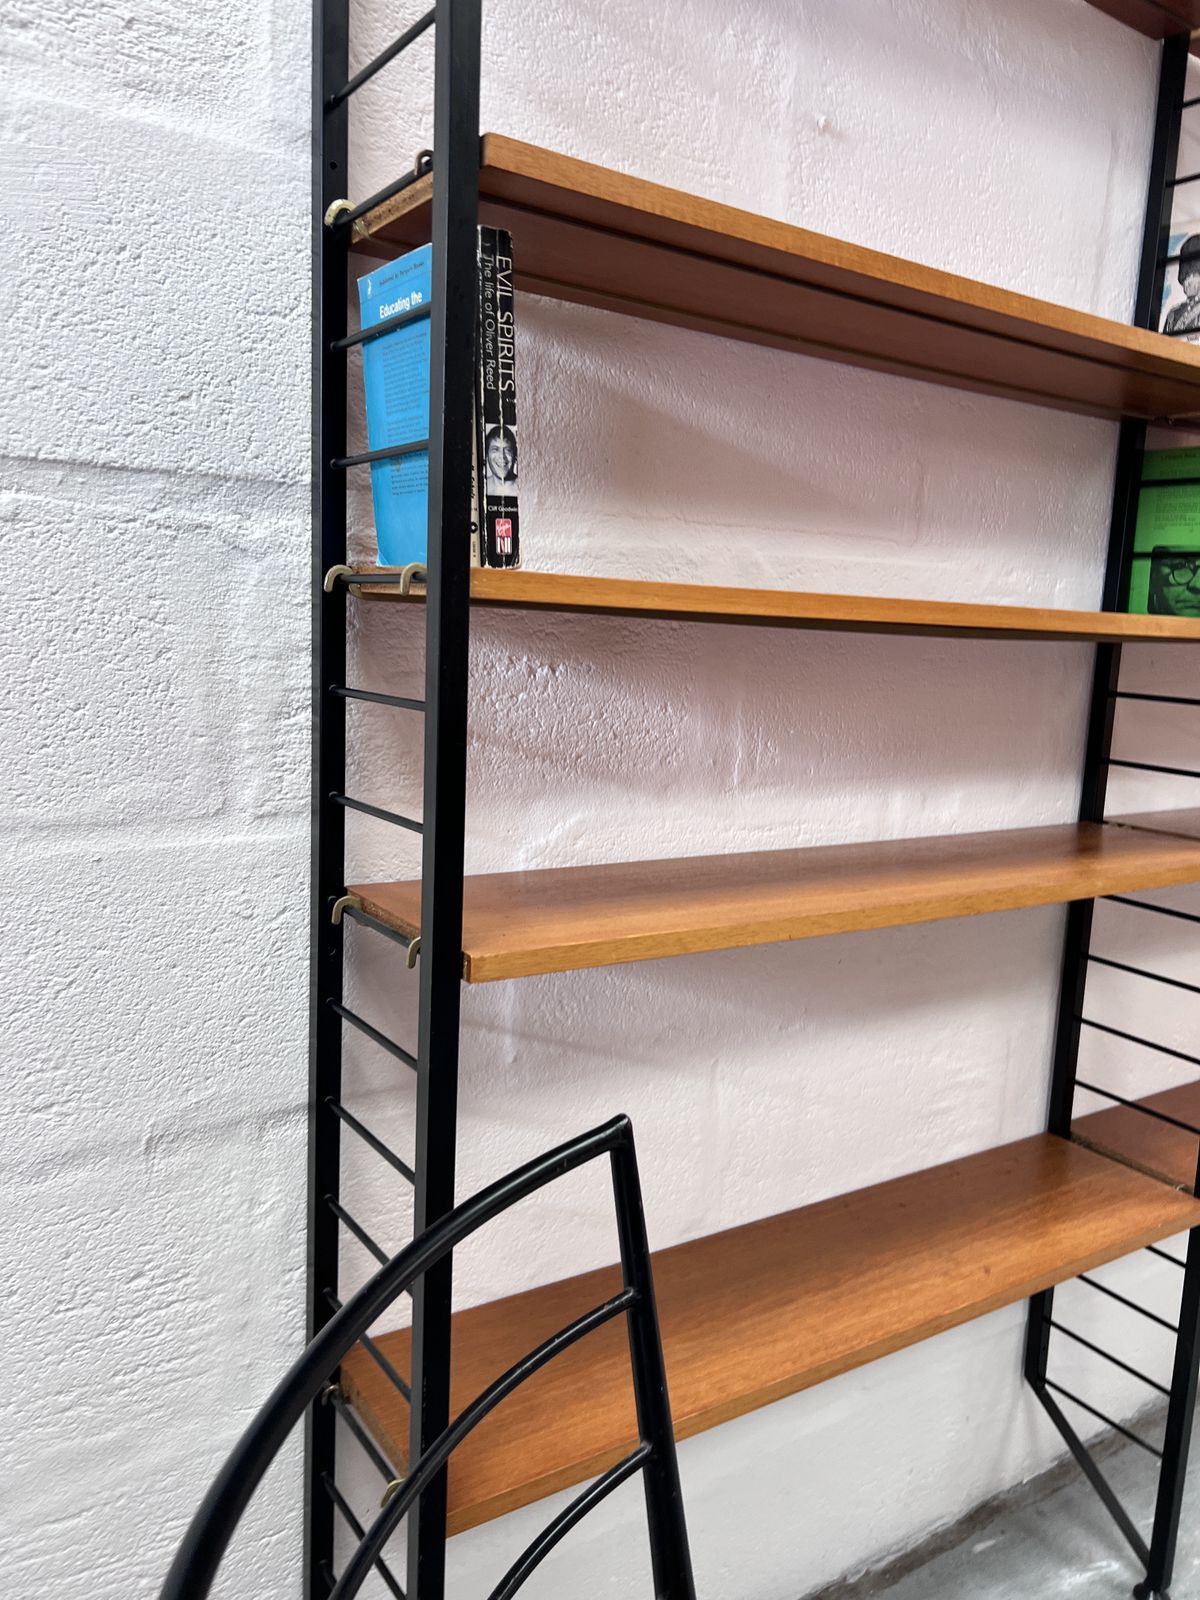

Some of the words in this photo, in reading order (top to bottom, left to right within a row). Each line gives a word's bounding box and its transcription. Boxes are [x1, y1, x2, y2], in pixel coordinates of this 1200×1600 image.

[482, 253, 495, 277] The
[496, 255, 513, 297] EVIL
[484, 278, 496, 299] life
[379, 297, 410, 319] Educating
[410, 290, 423, 305] the
[484, 302, 495, 316] of
[485, 317, 496, 357] Oliver
[497, 311, 515, 392] SPIRITS
[486, 359, 496, 390] Reed
